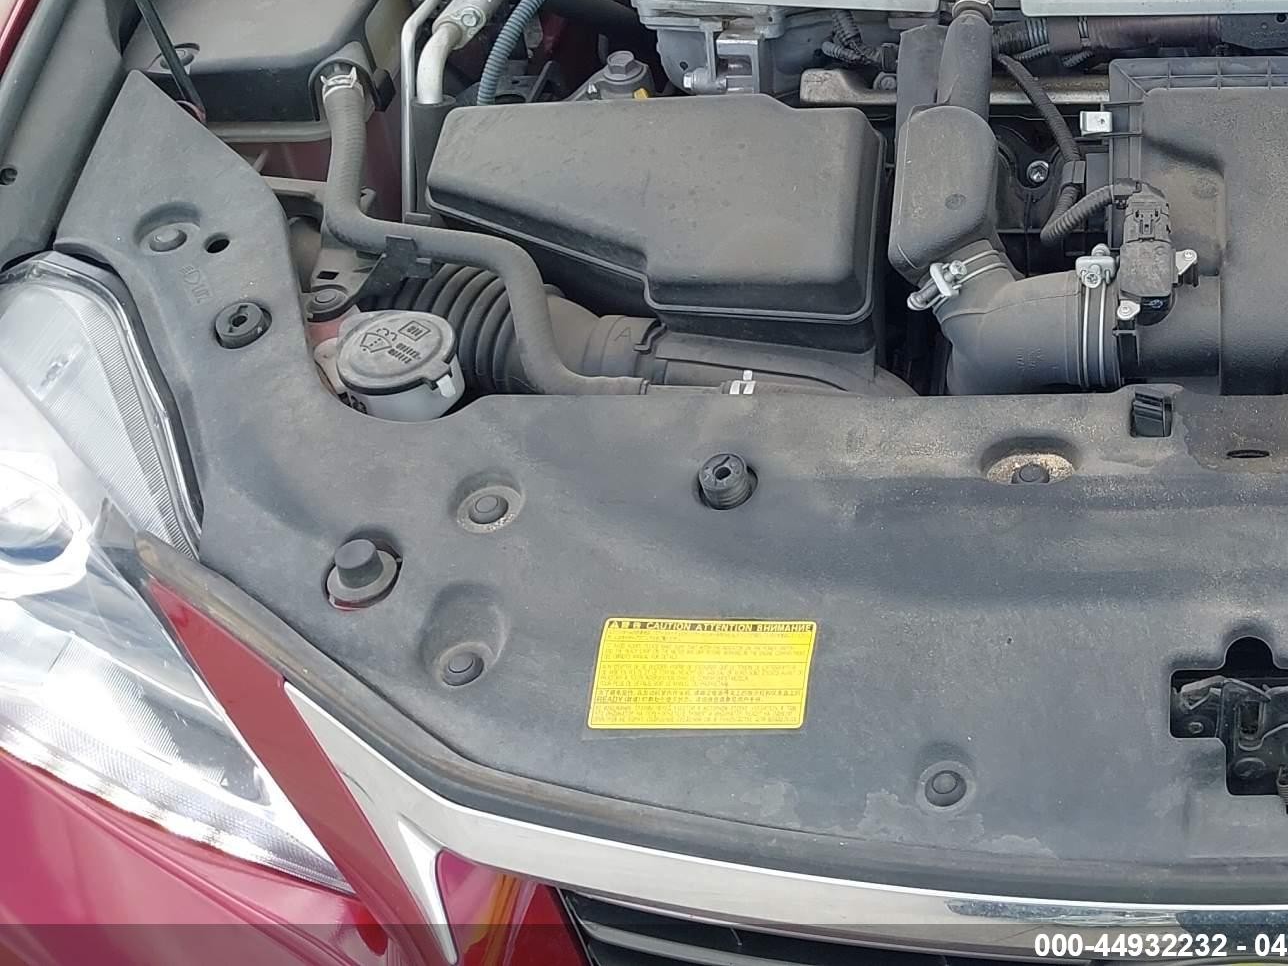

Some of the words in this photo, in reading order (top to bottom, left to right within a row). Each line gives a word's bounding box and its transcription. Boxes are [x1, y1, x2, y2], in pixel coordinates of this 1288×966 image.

[646, 622, 691, 631] CAUTION
[695, 623, 752, 632] ATTENTION
[756, 624, 812, 632] ВНИМАНИЕ
